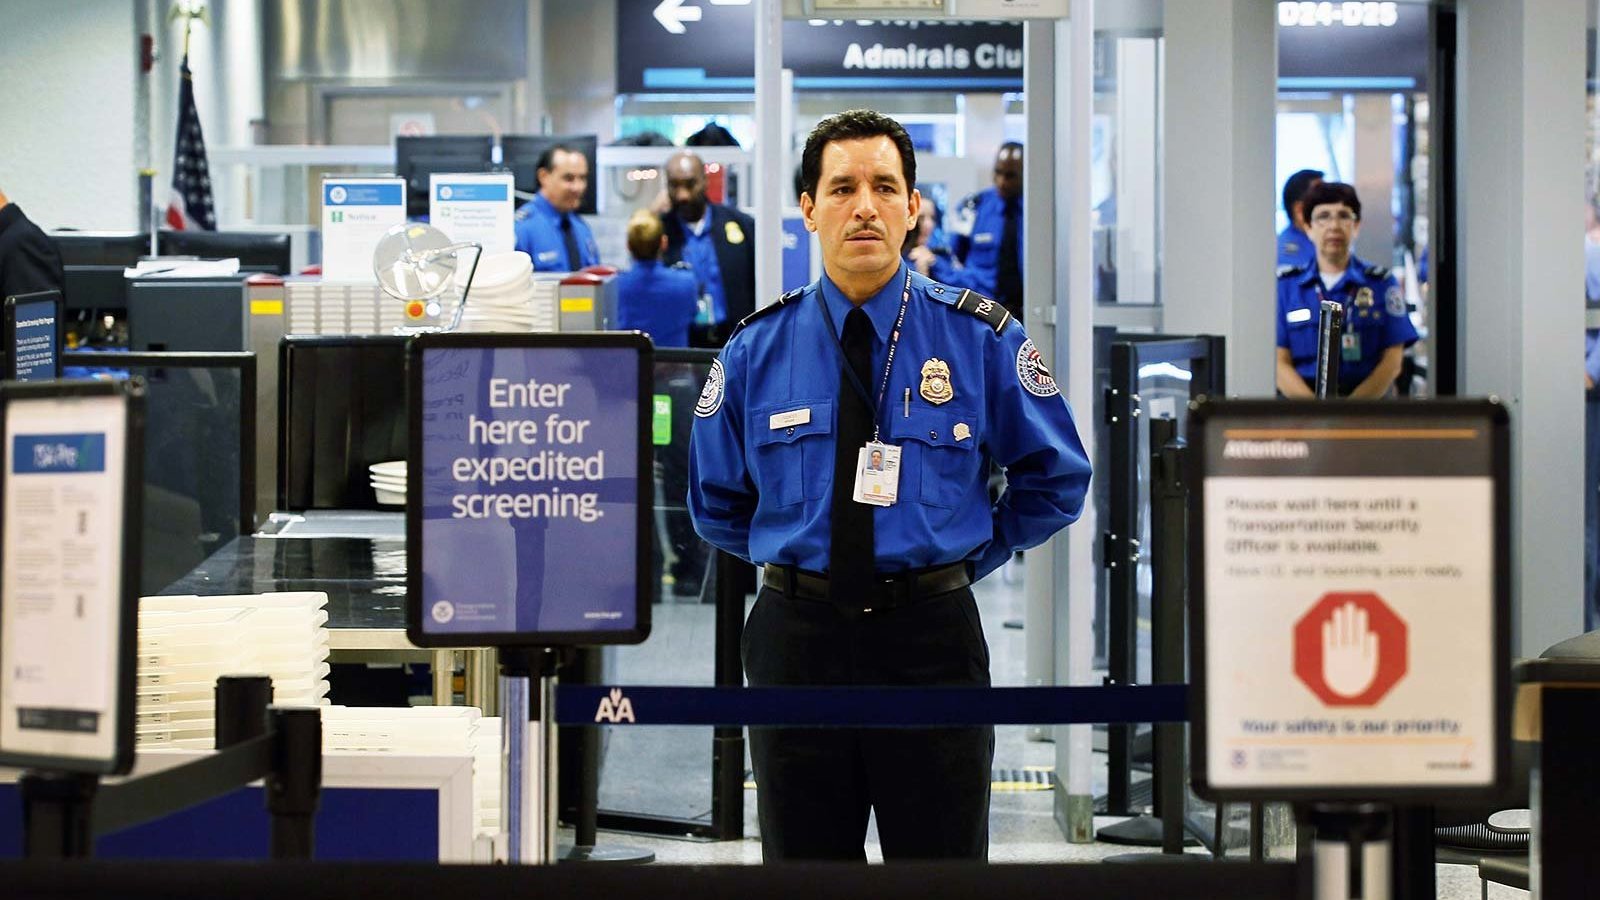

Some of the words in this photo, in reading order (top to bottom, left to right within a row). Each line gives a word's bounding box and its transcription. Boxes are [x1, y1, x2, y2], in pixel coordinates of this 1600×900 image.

[843, 43, 970, 69] Admirals
[975, 298, 997, 316] TSA
[489, 378, 571, 408] Enter
[468, 414, 538, 444] here
[545, 413, 590, 444] for
[1223, 439, 1309, 459] Attention
[452, 449, 604, 486] expedited
[452, 486, 604, 522] screening.
[1225, 497, 1278, 511] Please
[1285, 497, 1318, 511] wait
[1327, 497, 1361, 511] here
[1367, 497, 1402, 511] until
[1226, 517, 1347, 533] Transportation
[1354, 517, 1420, 534] Security
[1225, 537, 1281, 552] Officer
[595, 692, 635, 723] AA
[1242, 719, 1279, 733] Your
[1286, 719, 1336, 735] safety
[1362, 722, 1390, 733] our
[1393, 719, 1461, 735] priority
